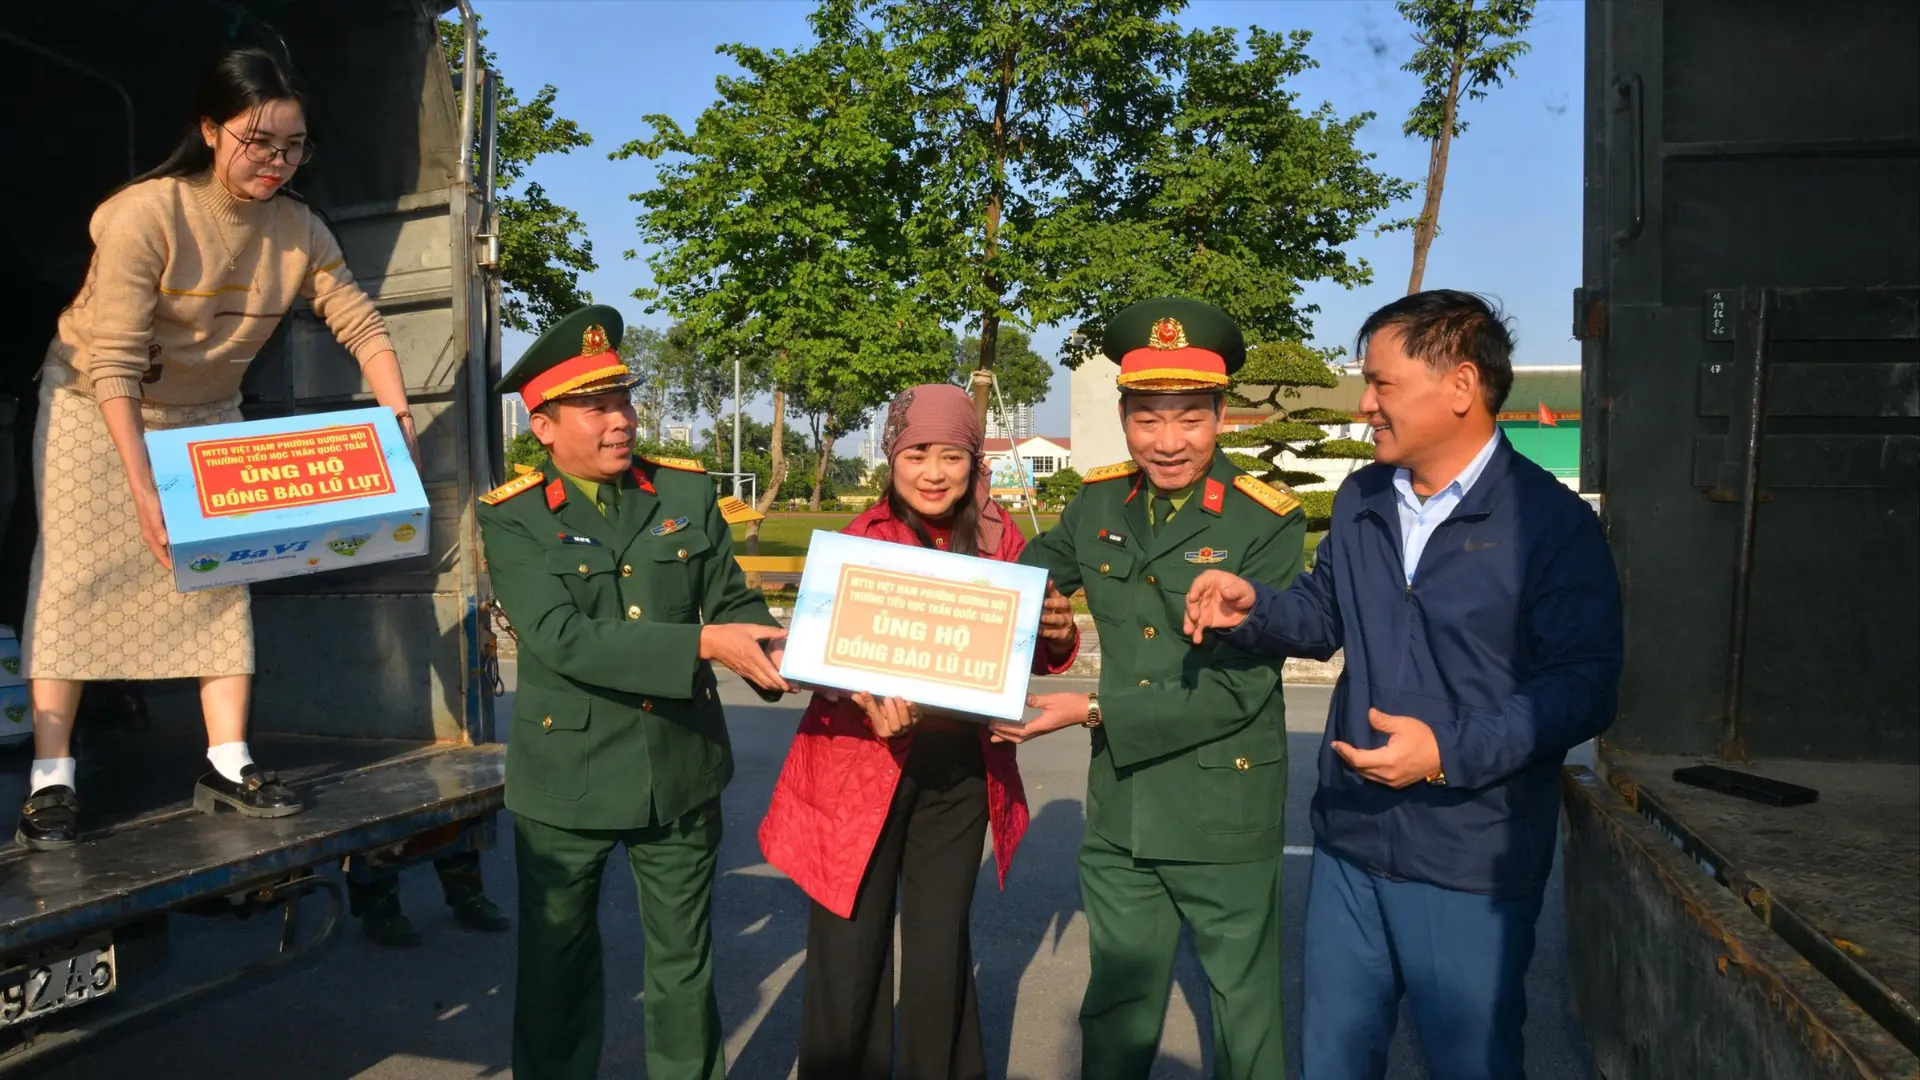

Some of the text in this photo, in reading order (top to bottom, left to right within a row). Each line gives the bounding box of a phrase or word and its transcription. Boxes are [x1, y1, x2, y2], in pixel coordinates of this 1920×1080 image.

[230, 445, 250, 454] VIỆT
[253, 443, 275, 452] NAM
[270, 452, 288, 460] HỌC
[240, 456, 344, 484] ỦNG HỘ
[273, 482, 314, 500] BÀO
[318, 477, 344, 494] LŨ
[347, 474, 380, 490] LỤT
[872, 609, 970, 652] ỦNG HỘ
[892, 645, 932, 669] BÀO
[935, 652, 960, 674] LŨ
[963, 658, 998, 682] LỤT
